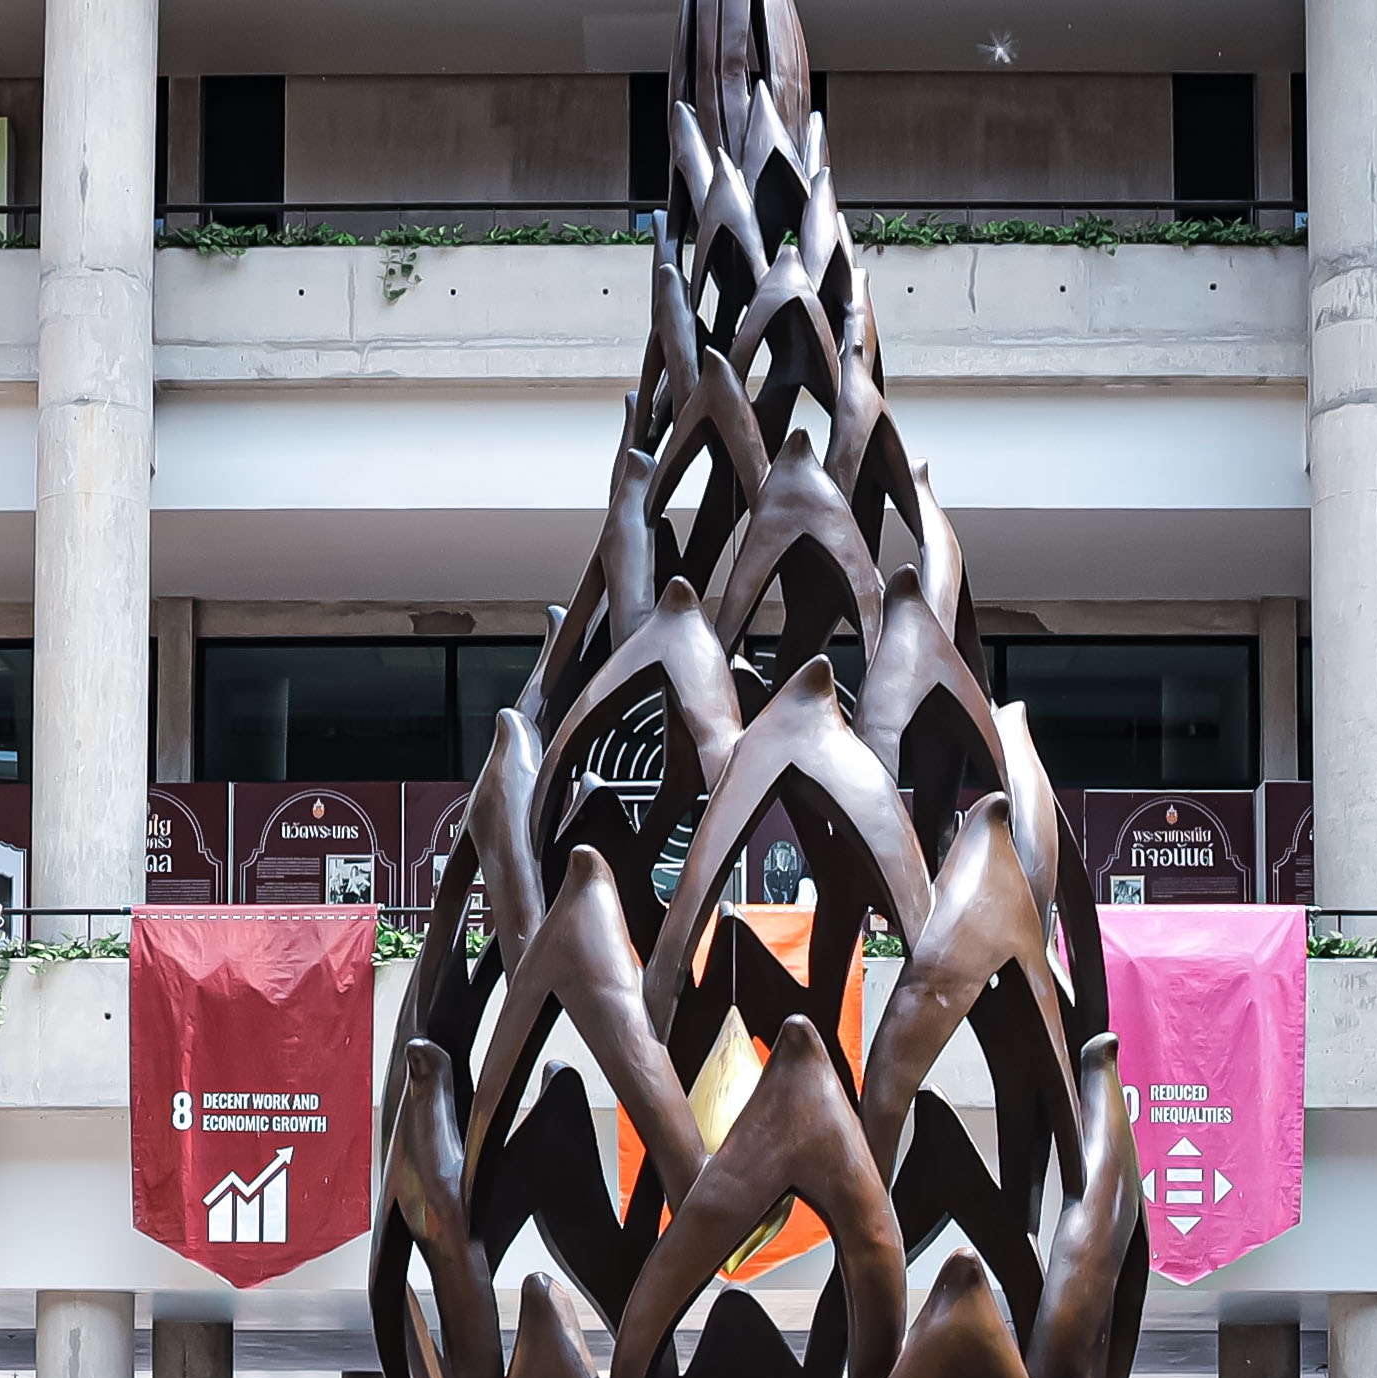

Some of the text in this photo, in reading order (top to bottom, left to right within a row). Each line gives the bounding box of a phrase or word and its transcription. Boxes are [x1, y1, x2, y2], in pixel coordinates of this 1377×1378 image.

[1131, 842, 1215, 867] กิจอนันต์
[202, 1093, 319, 1111] DECENT WORK AND
[1150, 1085, 1208, 1101] REDUCED
[172, 1091, 193, 1130] 8
[1150, 1108, 1233, 1125] INEQUALITIES
[202, 1115, 328, 1133] ECONOMIC GROWTH
